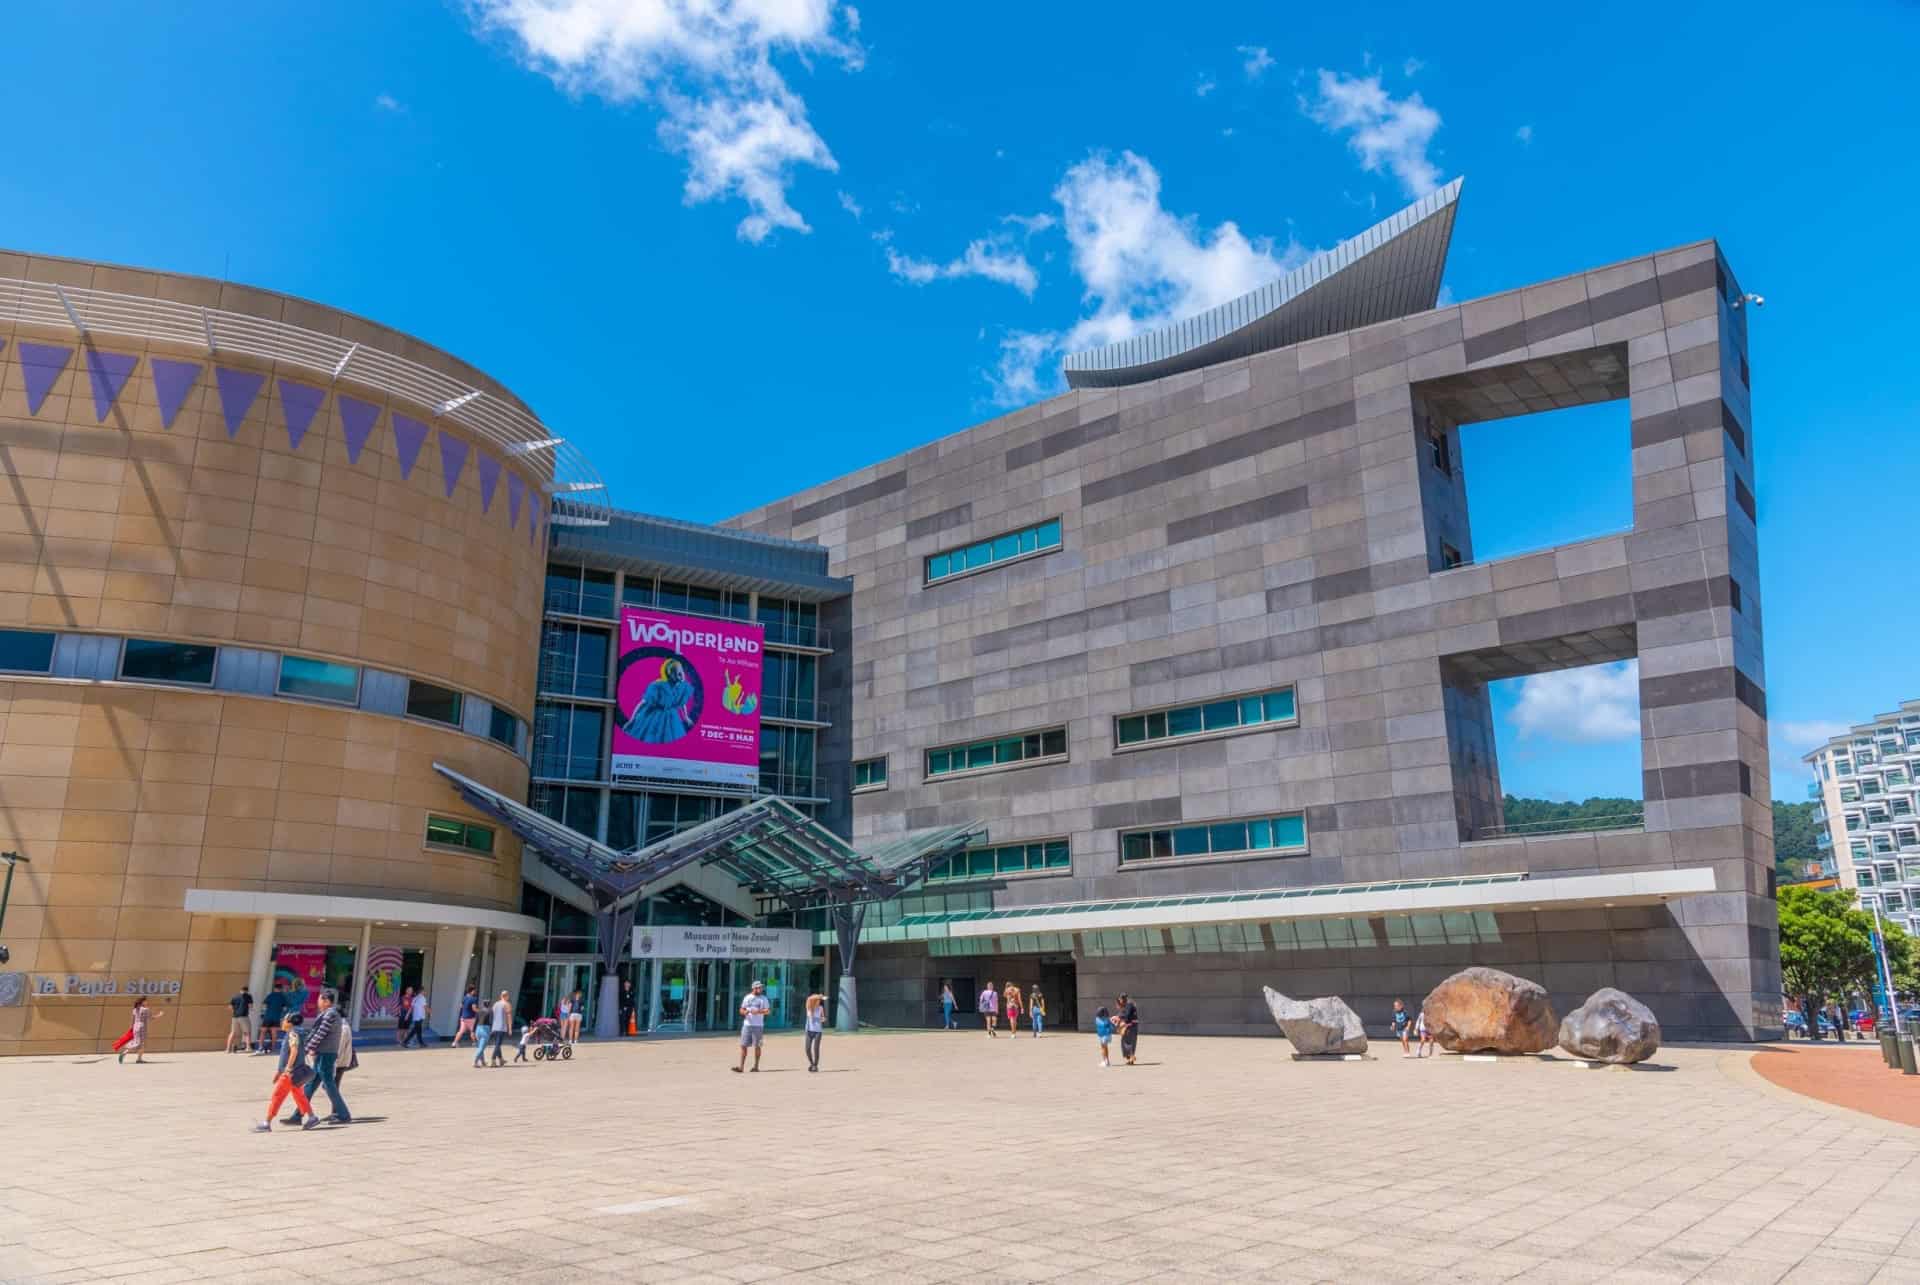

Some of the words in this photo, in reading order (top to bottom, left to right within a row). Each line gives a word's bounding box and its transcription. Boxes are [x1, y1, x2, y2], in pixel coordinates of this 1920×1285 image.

[707, 730, 724, 739] DEC
[736, 733, 754, 743] MAR
[684, 931, 721, 941] Museum
[721, 932, 731, 941] of
[732, 931, 749, 941] New
[751, 932, 779, 943] Zealand
[695, 943, 705, 953] Te
[706, 943, 728, 955] Papa
[731, 944, 772, 955] Tongarewa
[65, 975, 117, 998] Papa
[125, 975, 181, 994] store
